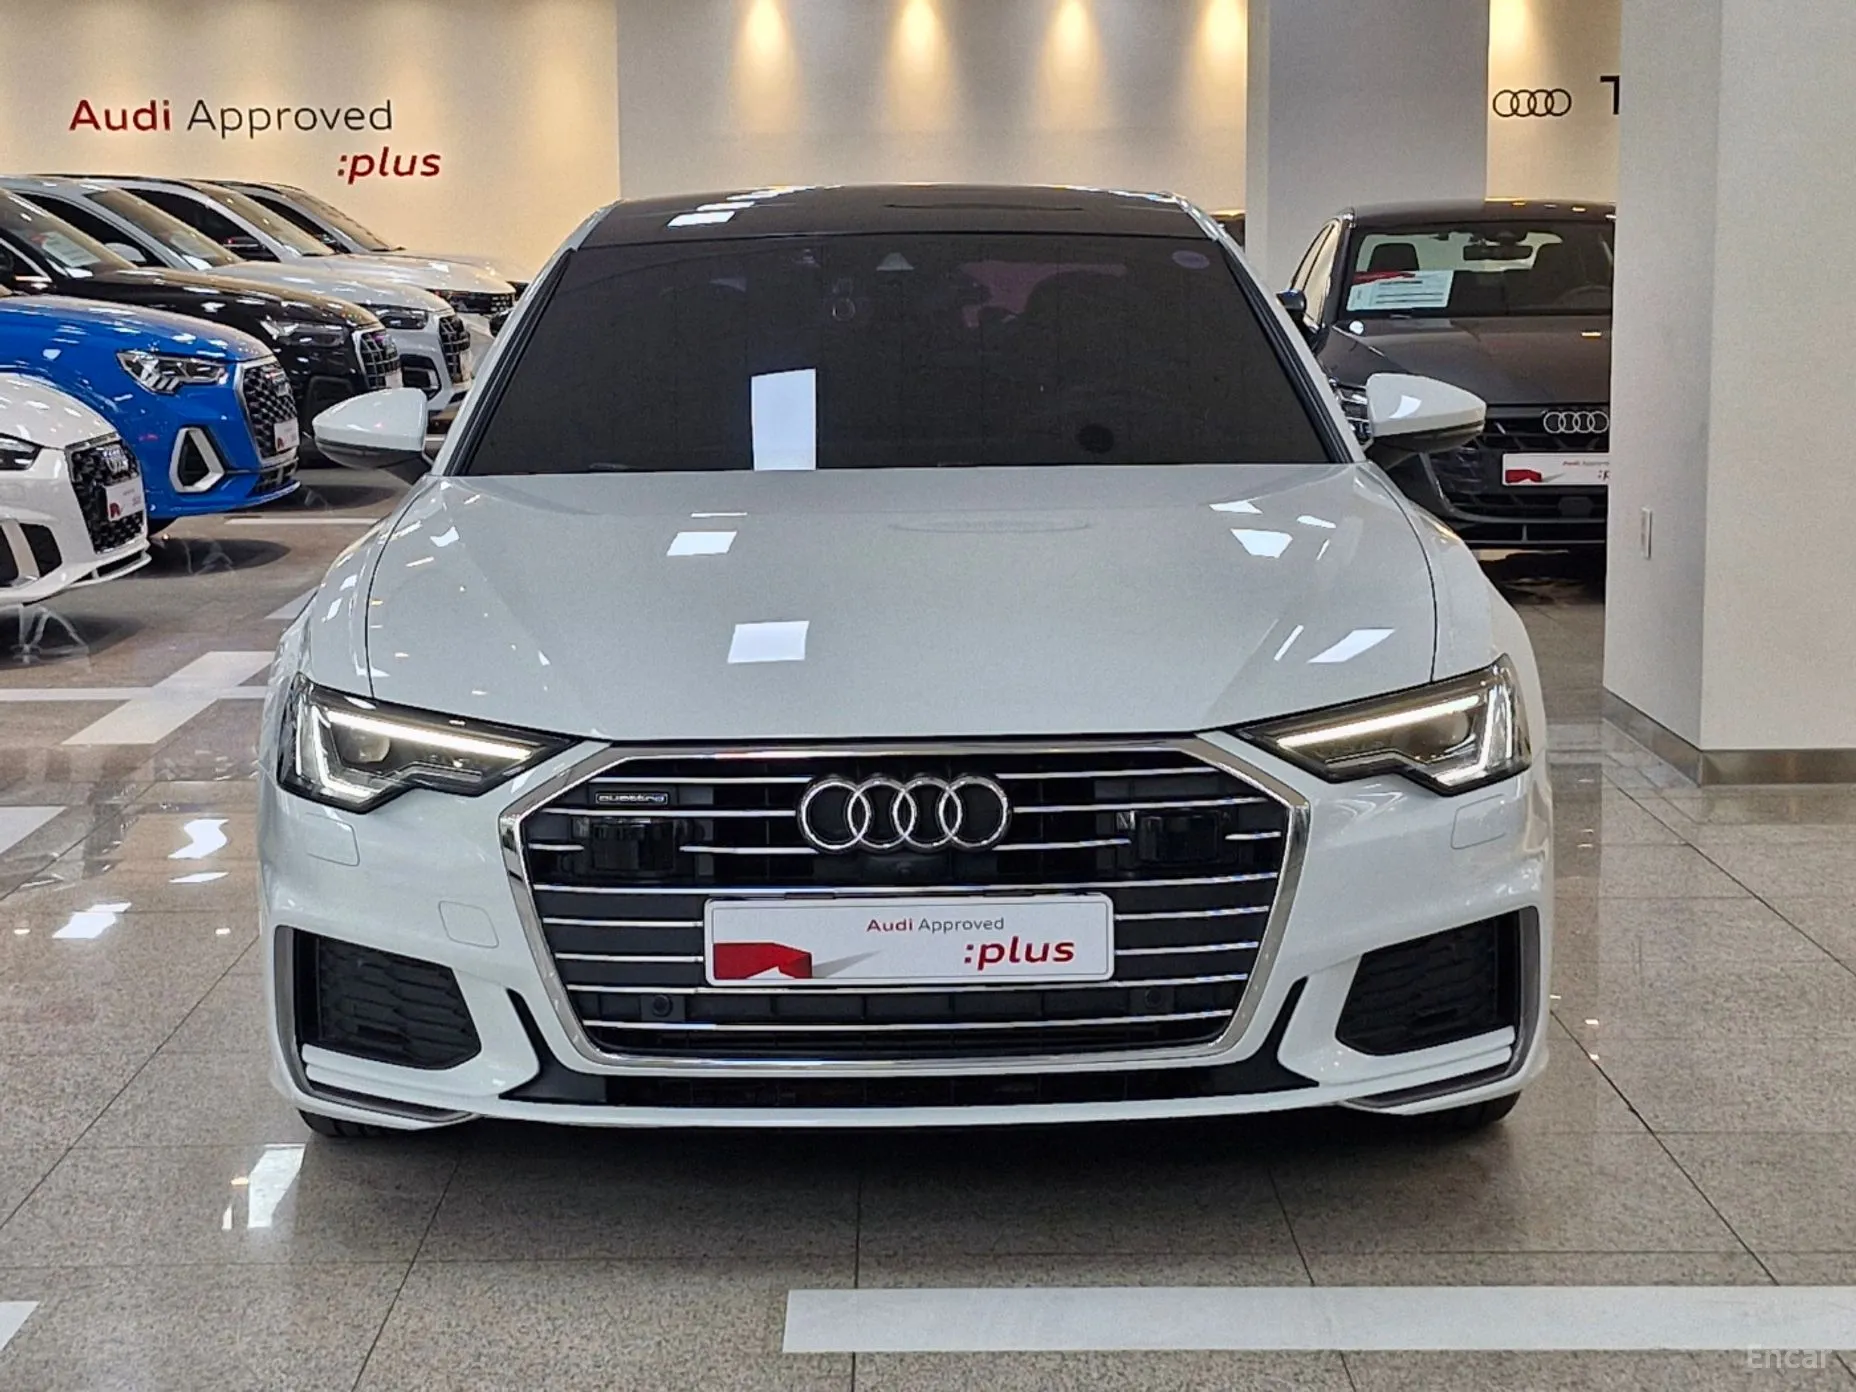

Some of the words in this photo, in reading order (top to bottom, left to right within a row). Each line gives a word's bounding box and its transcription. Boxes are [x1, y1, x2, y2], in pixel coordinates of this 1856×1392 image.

[69, 99, 171, 131] Audi
[187, 99, 392, 139] Approved
[337, 146, 441, 184] :plus
[866, 918, 913, 933] Audi
[918, 917, 1005, 934] Approved
[963, 936, 1075, 971] :plus
